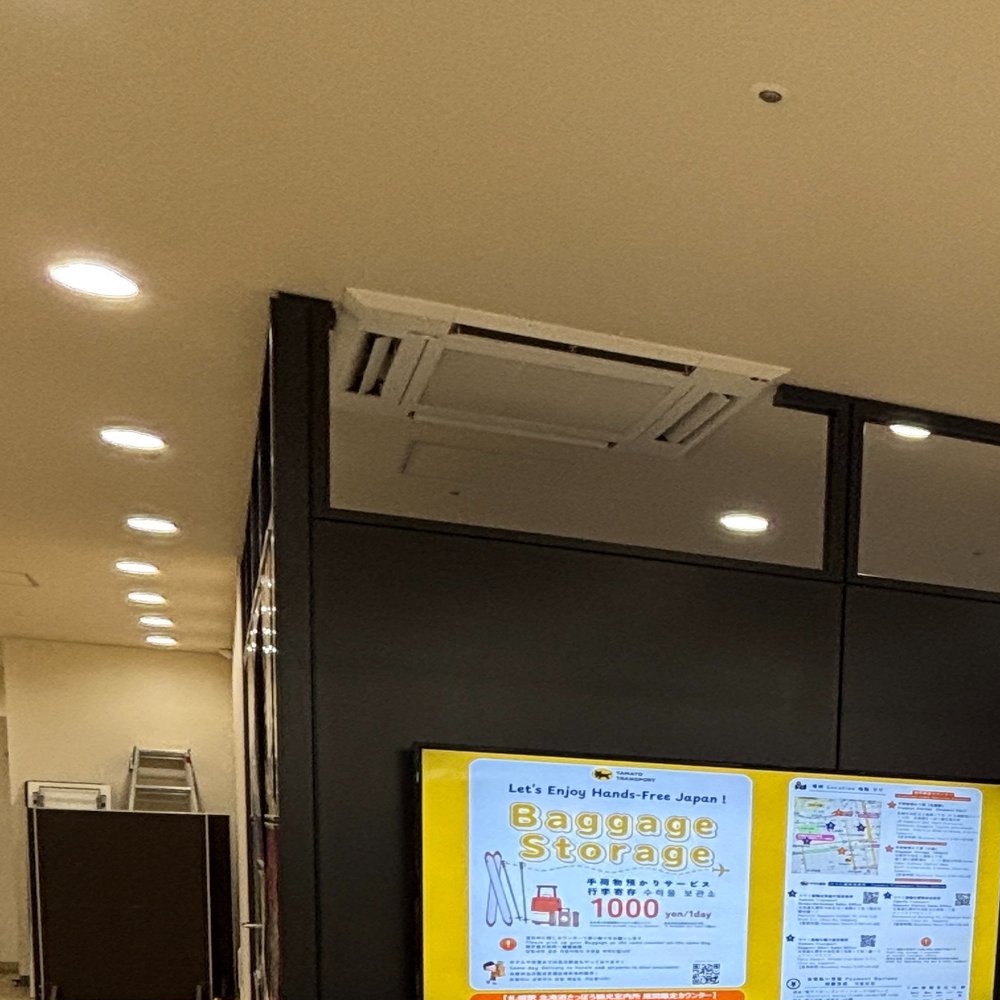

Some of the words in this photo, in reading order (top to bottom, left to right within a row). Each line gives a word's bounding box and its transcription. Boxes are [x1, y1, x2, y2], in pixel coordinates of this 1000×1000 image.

[509, 783, 542, 795] Let's
[547, 785, 586, 799] Enjoy
[592, 788, 671, 801] Hands-Free
[675, 793, 718, 805] Japan
[509, 802, 717, 841] Baggage
[519, 833, 714, 871] Storage
[591, 898, 660, 919] 1000
[665, 910, 712, 920] yen/1day
